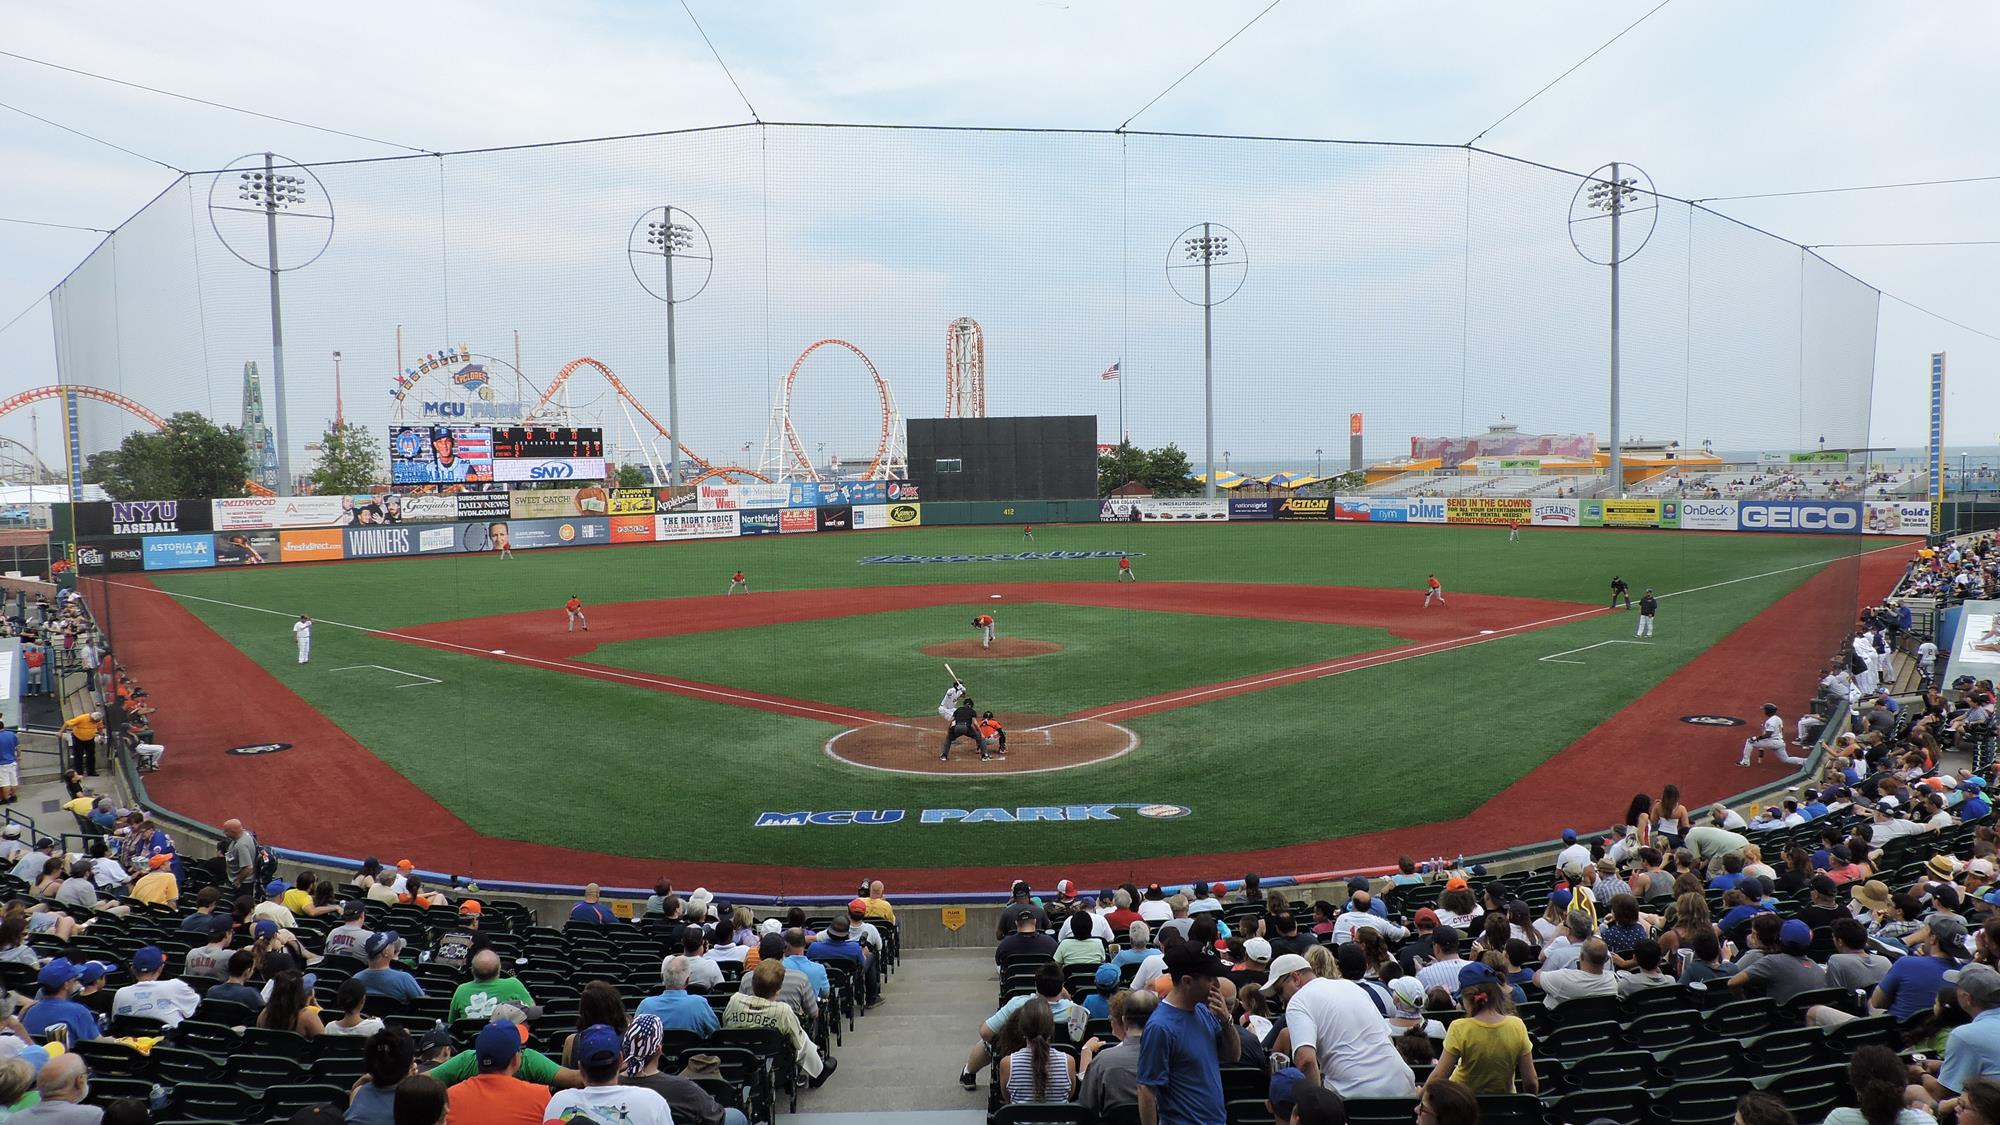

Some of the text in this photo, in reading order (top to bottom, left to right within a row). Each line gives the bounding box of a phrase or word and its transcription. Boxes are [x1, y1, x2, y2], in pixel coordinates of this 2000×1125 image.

[454, 371, 489, 385] CYCLONES
[423, 402, 523, 418] MCU PARK
[530, 466, 567, 478] SNY
[701, 487, 729, 498] WONDER
[900, 486, 919, 497] MAX
[223, 499, 276, 508] MIDWOOD
[514, 496, 541, 504] SWEET
[656, 492, 696, 512] Applebee's
[715, 498, 737, 509] WHEEL
[1280, 498, 1329, 511] ACTION
[1447, 498, 1532, 508] SEND IN THE CLOWNS
[112, 500, 178, 523] NYU
[1545, 505, 1576, 518] FRANCIS
[1901, 508, 1930, 516] Gold's
[663, 515, 733, 525] THE RIGHT CHOICE
[742, 513, 778, 523] Northfield
[1741, 506, 1857, 529] GEICO
[113, 522, 179, 535] BASEBALL
[150, 542, 192, 552] ASTORIA
[349, 529, 409, 556] WINNERS
[78, 548, 98, 557] Get
[110, 549, 142, 560] PREMIO
[754, 805, 1121, 827] MCU PARK
[732, 1012, 777, 1029] HODGES
